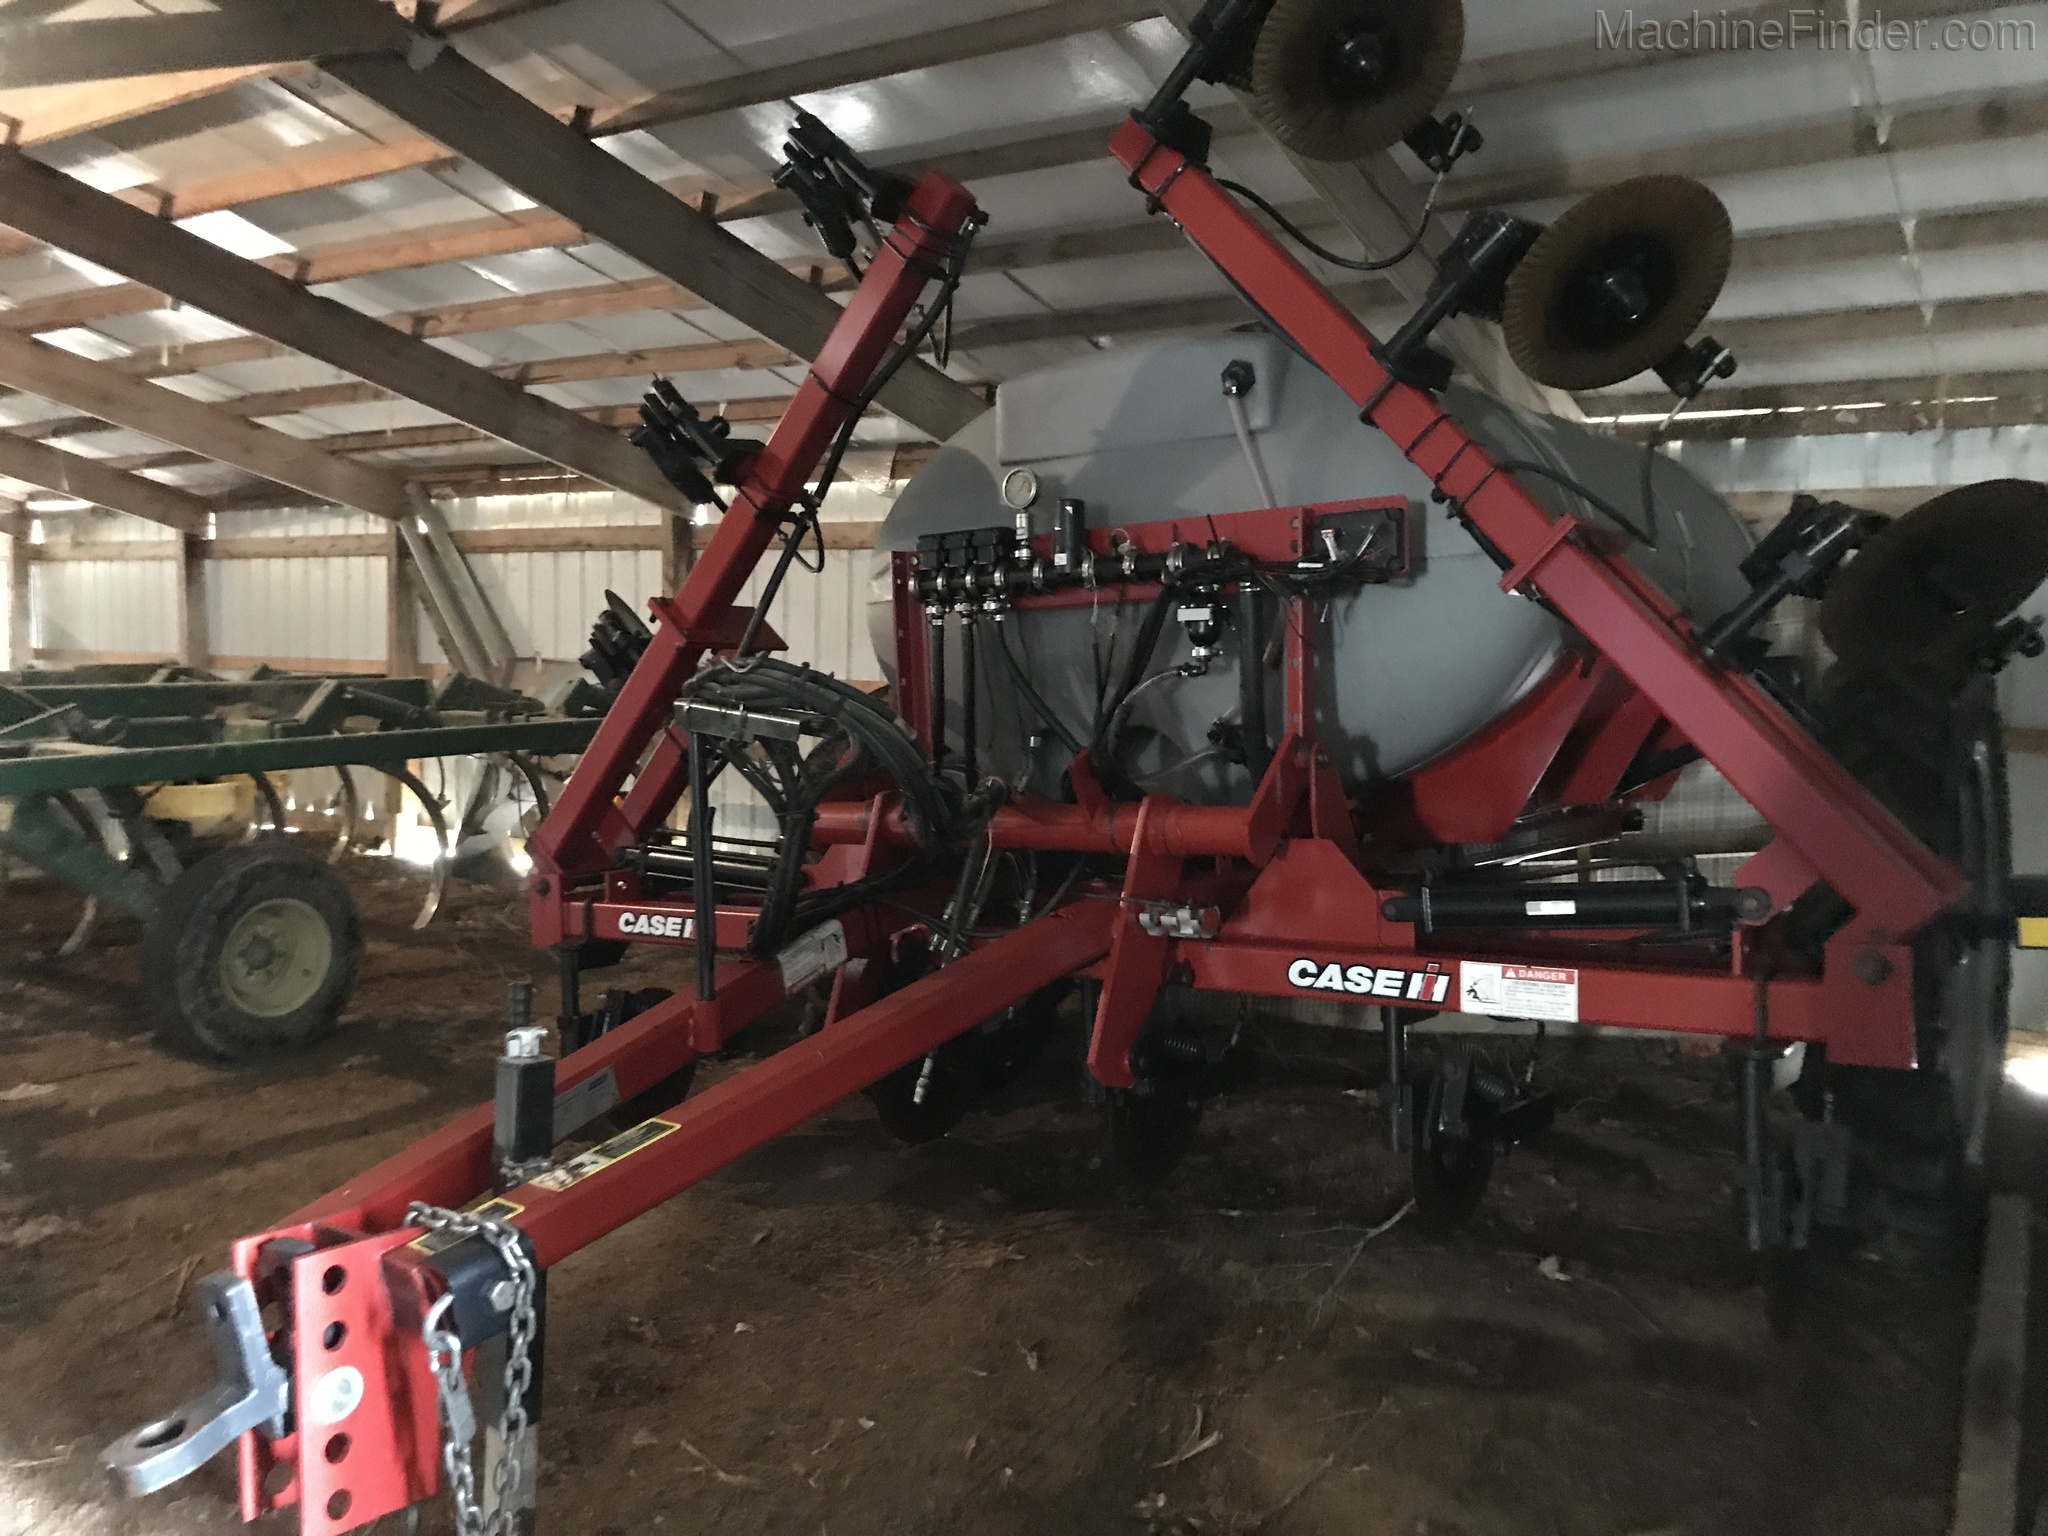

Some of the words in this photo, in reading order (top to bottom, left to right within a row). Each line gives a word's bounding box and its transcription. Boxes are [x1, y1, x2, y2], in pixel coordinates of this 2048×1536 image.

[618, 912, 683, 937] CASE
[1288, 959, 1405, 997] CASE
[1518, 969, 1567, 982] DANGER
